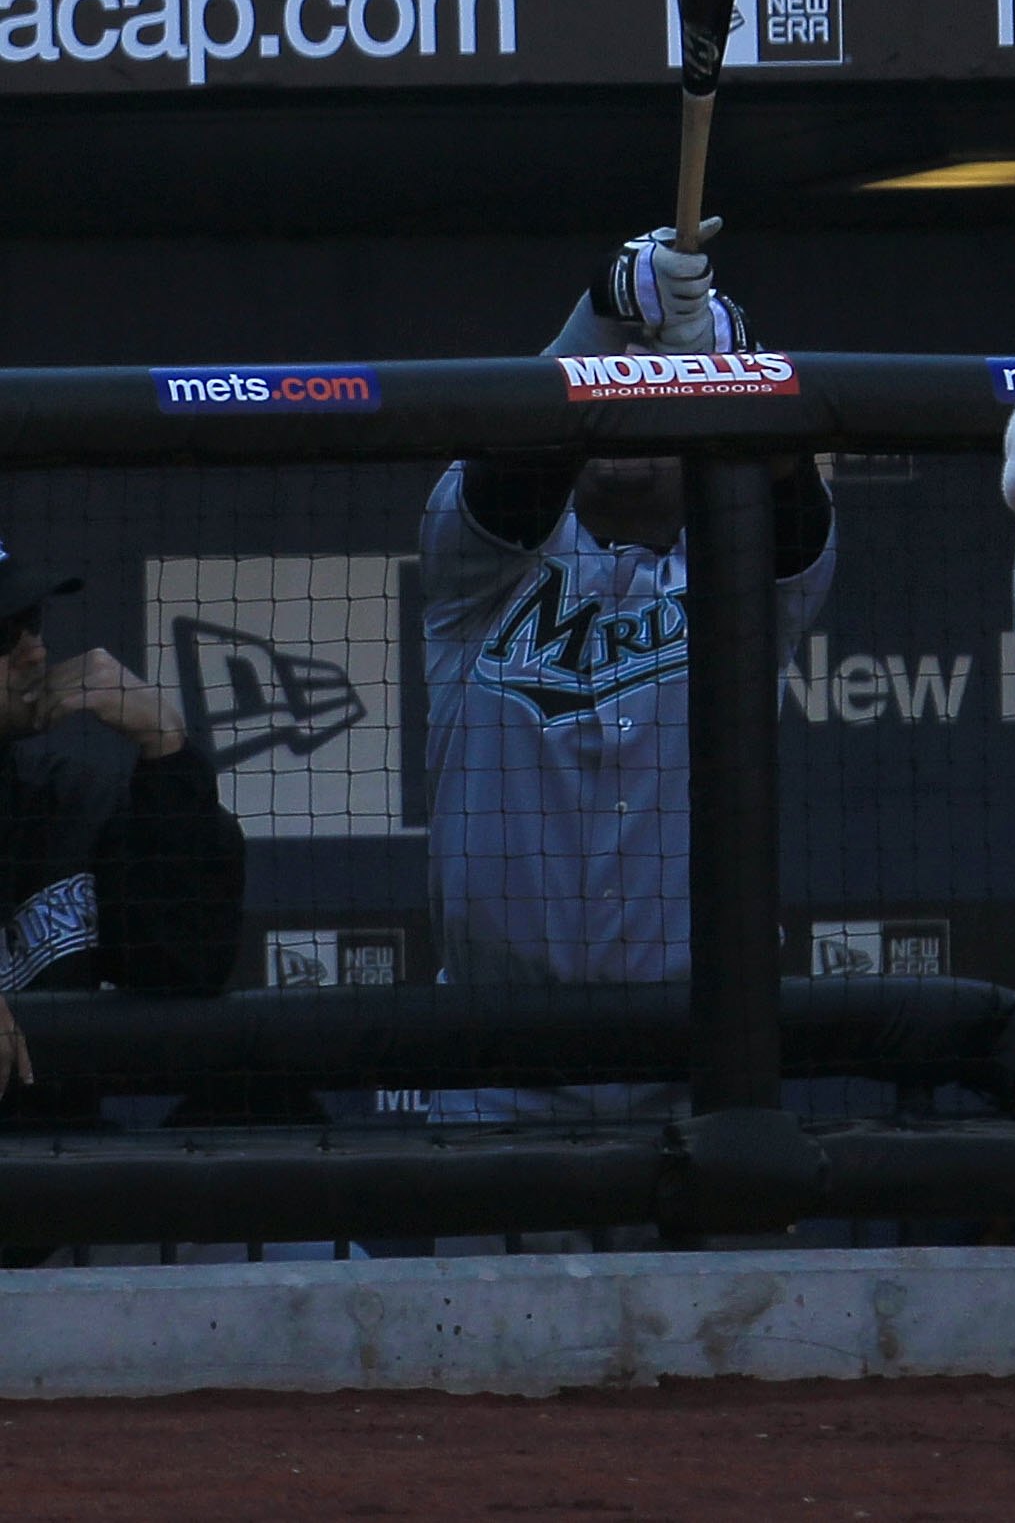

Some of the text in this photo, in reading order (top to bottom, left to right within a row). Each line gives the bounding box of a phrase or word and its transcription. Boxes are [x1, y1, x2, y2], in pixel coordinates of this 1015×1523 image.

[767, 16, 831, 44] ERA
[558, 353, 794, 386] MODELL'S
[167, 372, 370, 404] mets.com
[591, 383, 774, 397] SPORTING GOODS
[891, 937, 940, 957] NEW
